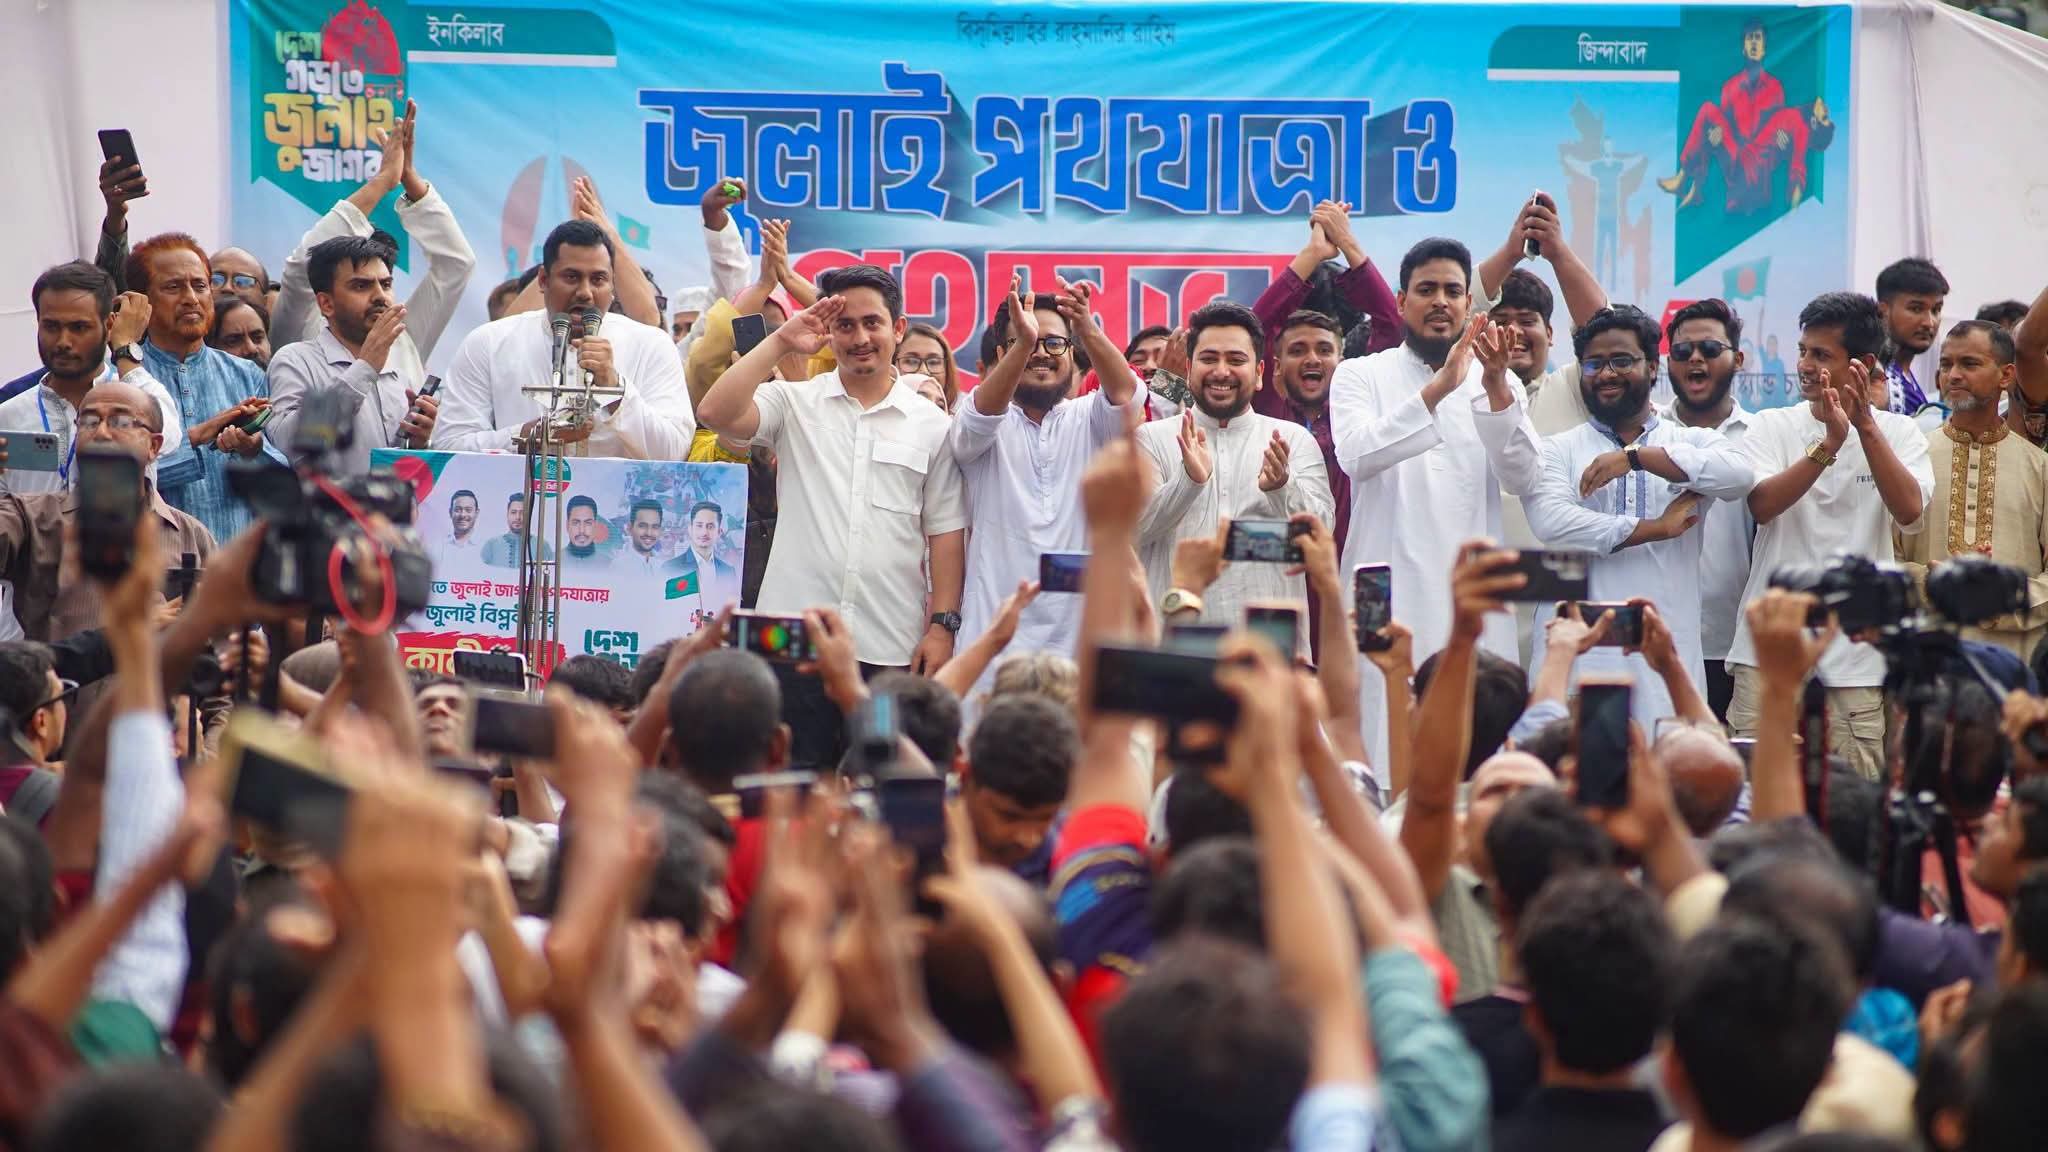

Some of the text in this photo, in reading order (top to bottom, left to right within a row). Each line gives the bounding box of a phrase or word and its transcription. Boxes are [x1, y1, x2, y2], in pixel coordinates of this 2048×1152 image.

[426, 13, 504, 46] ইনকিলাব
[275, 31, 322, 63] দেশ
[1577, 32, 1648, 64] জিন্দাবাদ
[637, 61, 1457, 256] জুলাই পথযাত্রা ও
[450, 580, 493, 602] জুলাই
[426, 603, 477, 627] জুলাই
[584, 629, 639, 655] দেশ
